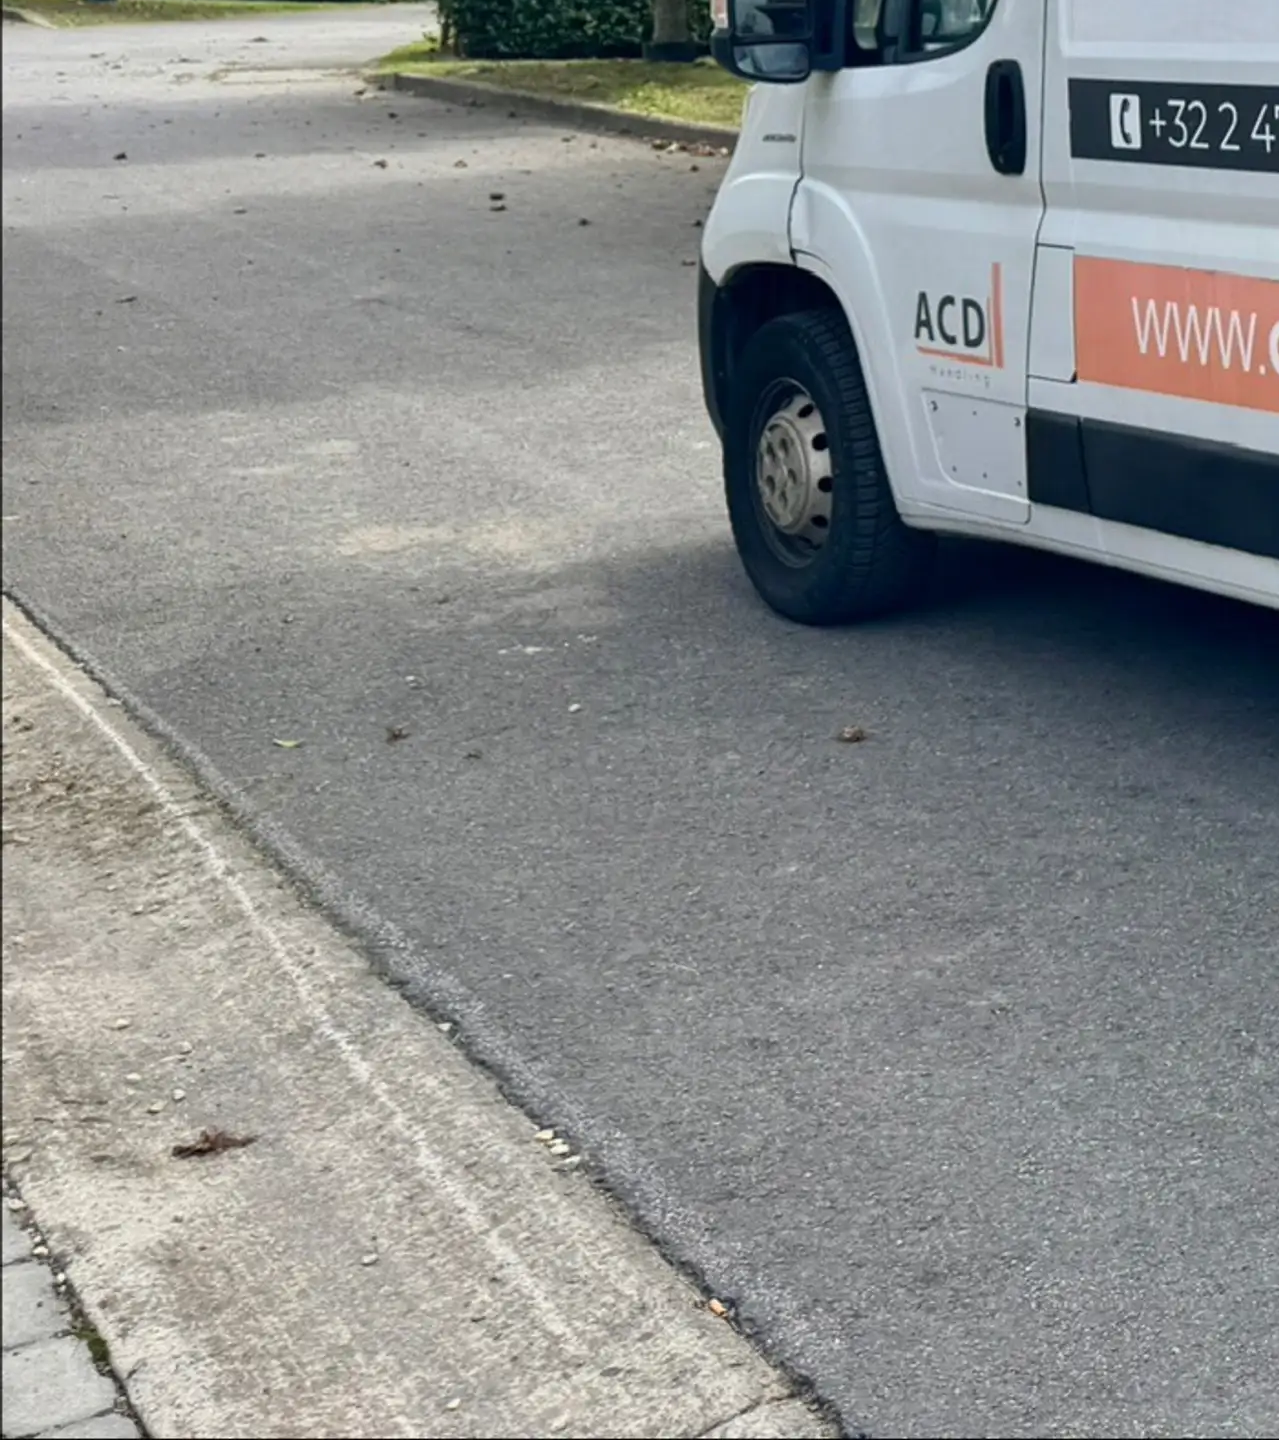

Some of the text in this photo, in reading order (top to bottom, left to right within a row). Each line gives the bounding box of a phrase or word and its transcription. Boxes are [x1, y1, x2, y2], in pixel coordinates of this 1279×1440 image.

[1149, 100, 1210, 150] +32
[1218, 101, 1241, 152] 2
[914, 290, 986, 349] ACD
